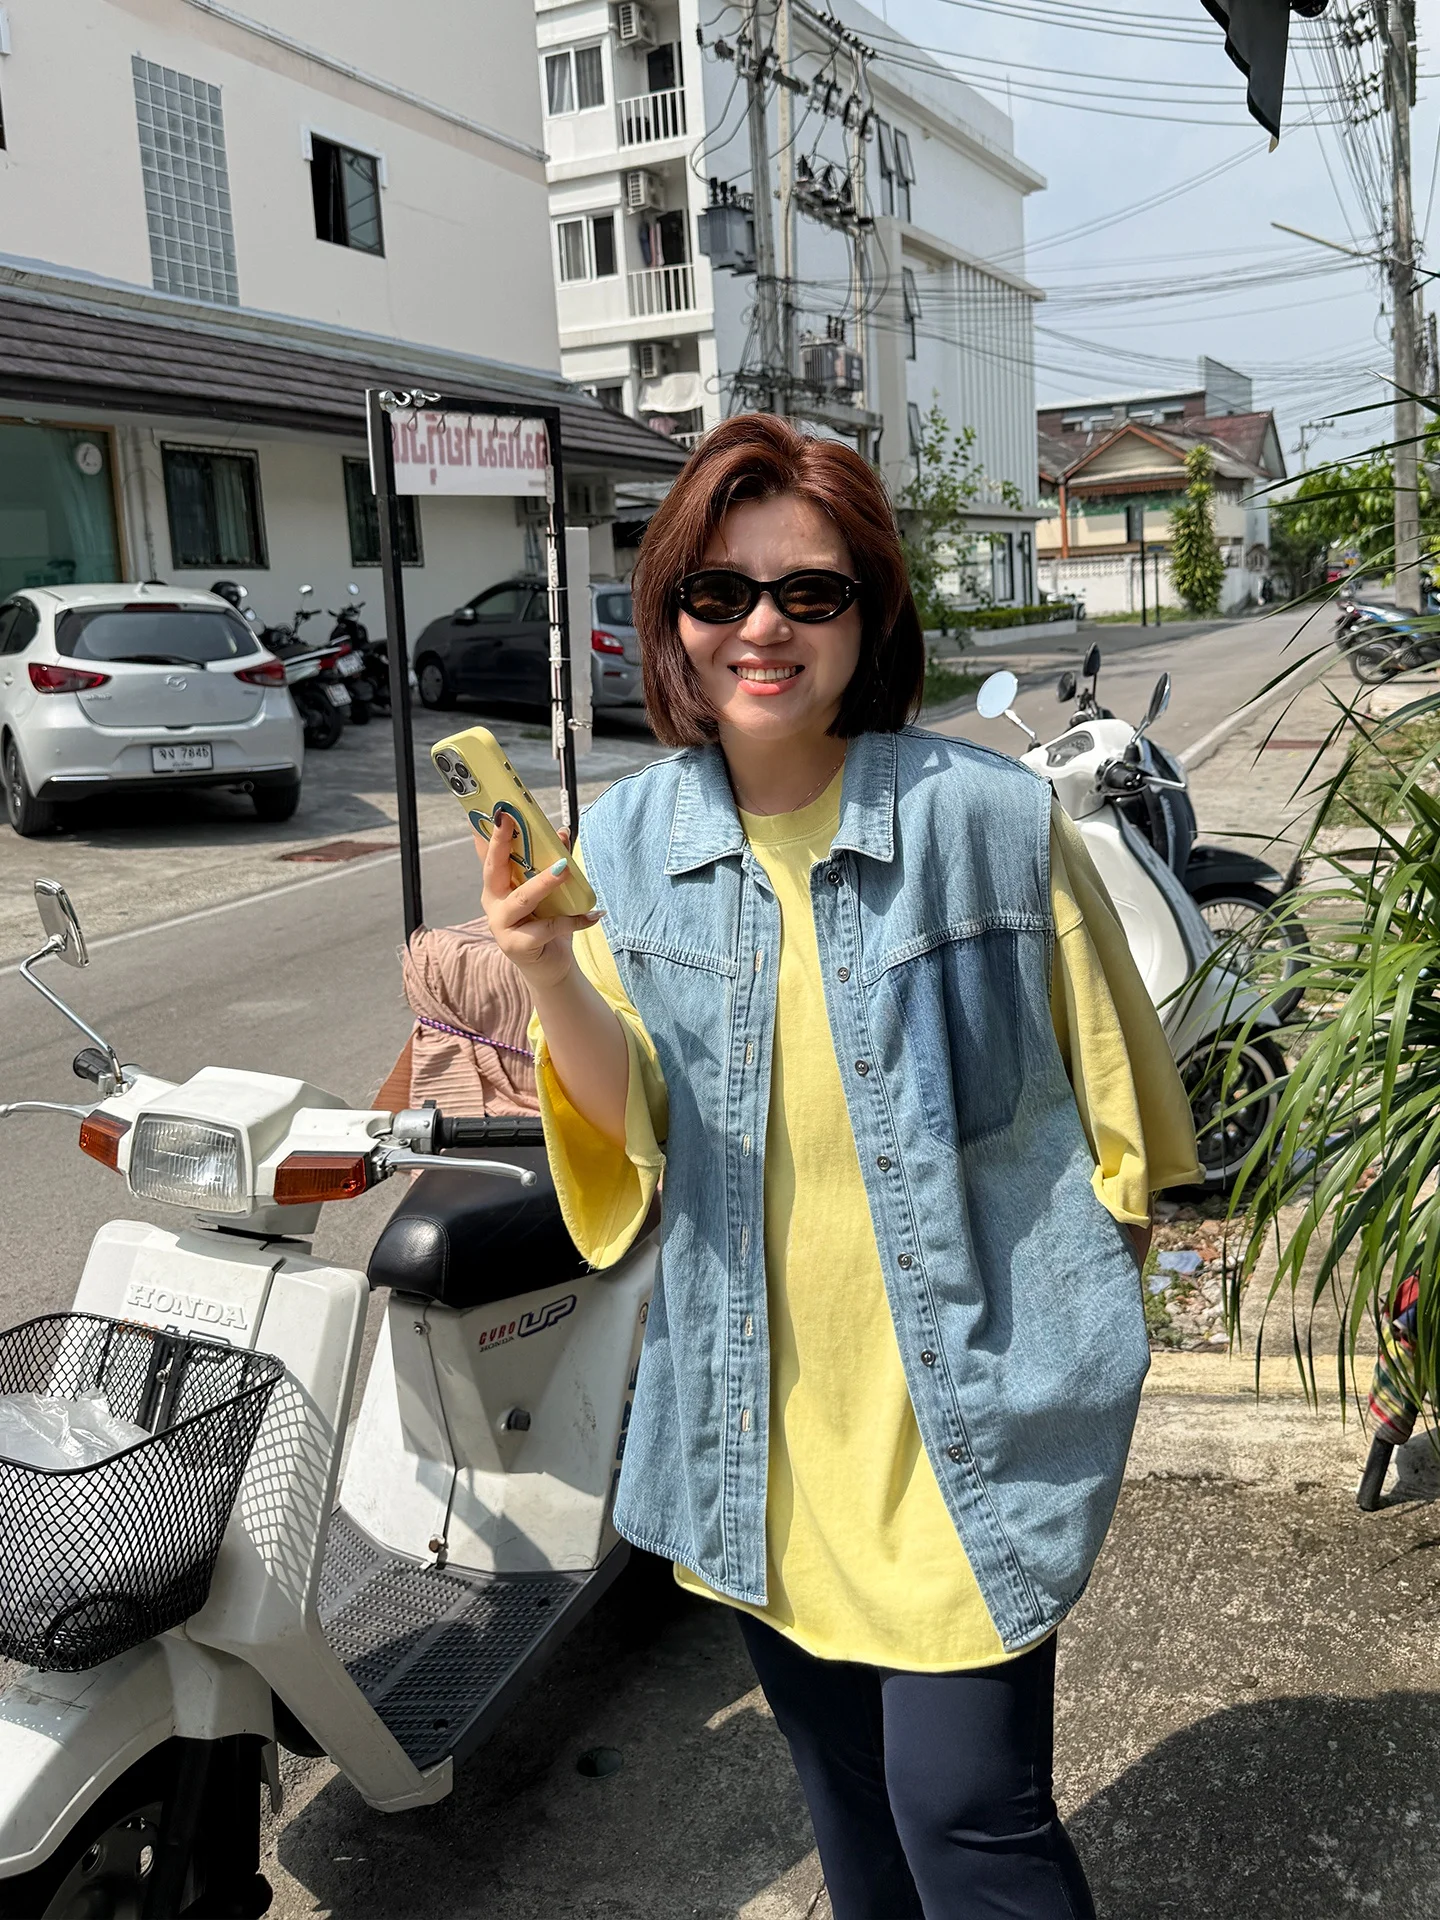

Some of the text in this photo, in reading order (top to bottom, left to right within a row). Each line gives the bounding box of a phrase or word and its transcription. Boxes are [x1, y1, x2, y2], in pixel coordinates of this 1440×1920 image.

[127, 1284, 248, 1330] HONDA
[479, 1294, 577, 1345] GYRO UP
[480, 1335, 516, 1353] HONDA
